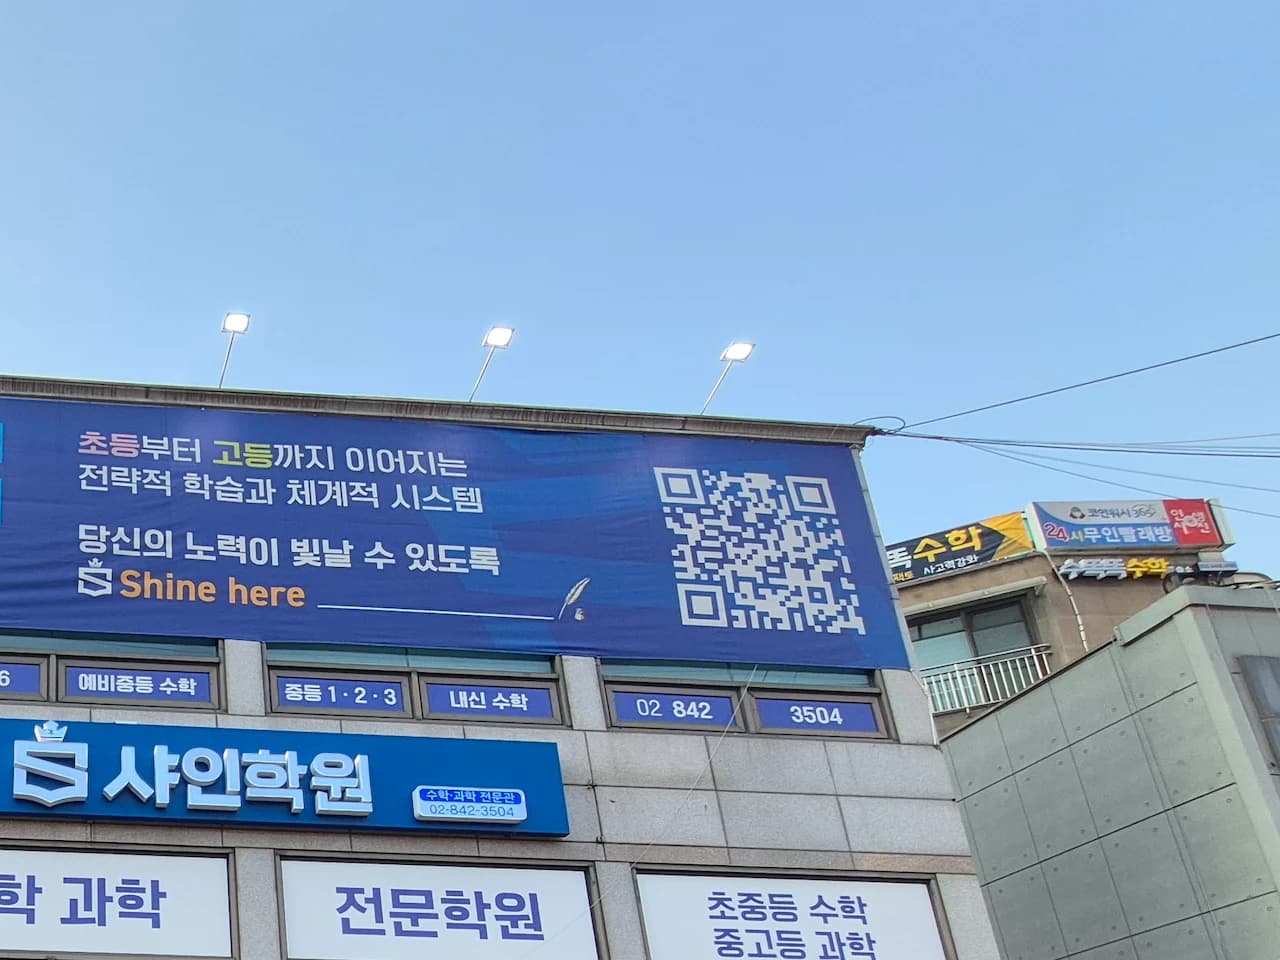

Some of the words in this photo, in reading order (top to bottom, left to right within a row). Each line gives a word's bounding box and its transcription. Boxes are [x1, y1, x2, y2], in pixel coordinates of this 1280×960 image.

[78, 430, 201, 464] 초등부터
[213, 439, 334, 472] 고등까지
[345, 447, 467, 478] 이어지는
[78, 464, 172, 497] 전략적
[184, 472, 276, 505] 학습과
[287, 479, 379, 509] 체계적
[392, 484, 484, 514] 시스템
[78, 523, 173, 559] 당신의
[185, 530, 280, 567] 노력이
[291, 536, 354, 569] 빛날
[364, 541, 395, 571] 수
[405, 544, 501, 577] 있도록
[912, 526, 983, 563] 수학
[120, 570, 216, 603] Shine
[229, 577, 306, 607] here
[78, 671, 154, 694] 예비중등
[159, 675, 198, 696] 수학
[284, 682, 322, 704] 중등
[449, 689, 488, 711] 내신
[491, 691, 529, 713] 수학
[636, 697, 661, 718] 02
[672, 699, 715, 721] 842
[790, 704, 844, 726] 3504
[103, 744, 375, 816] 샤인학원
[429, 804, 515, 817] 02-842-3504
[480, 791, 516, 805] 전문관
[60, 876, 167, 929] 과학
[335, 886, 545, 941] 전문학원
[707, 891, 799, 923] 초중등
[809, 894, 868, 925] 수학
[713, 927, 807, 960] 중고등
